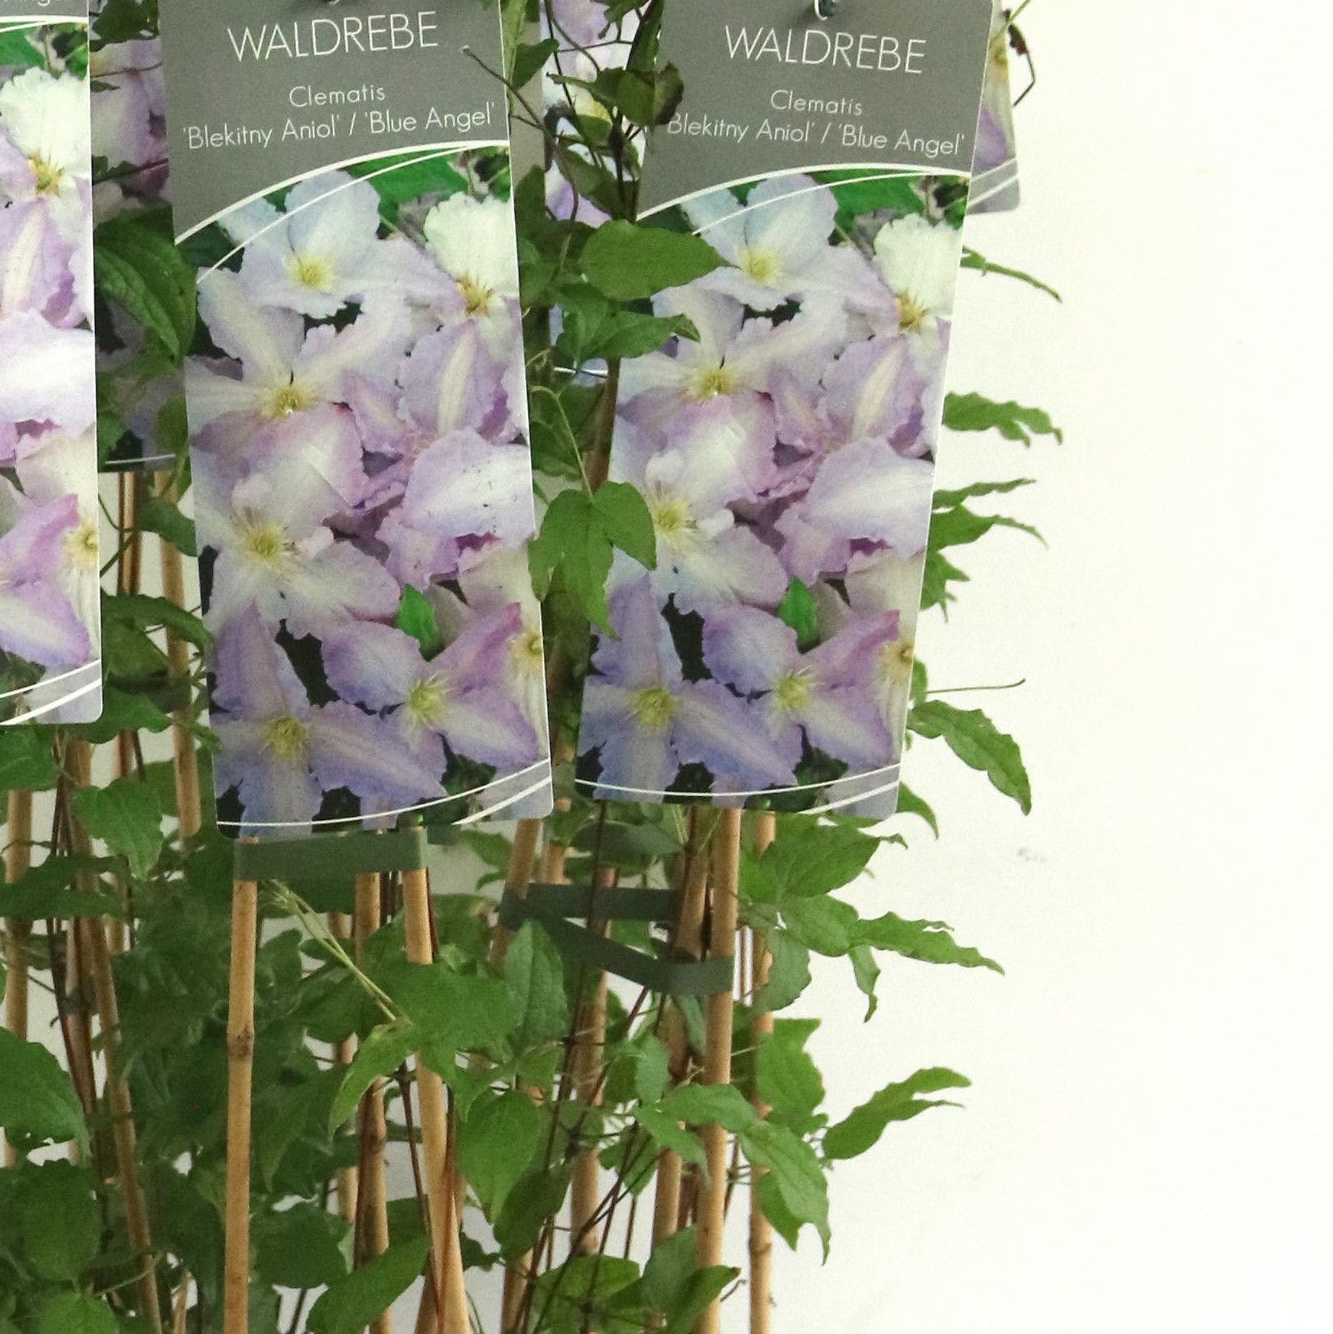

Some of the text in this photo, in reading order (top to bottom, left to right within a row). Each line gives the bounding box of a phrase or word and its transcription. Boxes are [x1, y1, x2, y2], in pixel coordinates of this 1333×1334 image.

[227, 10, 438, 62] WALDREBE
[724, 24, 927, 74] WALDREBE
[289, 84, 386, 108] Clematis
[770, 88, 863, 117] Clematis
[183, 101, 496, 149] 'Blekitny Aniol' / 'Blue Angel'
[667, 112, 966, 158] Blekitny Aniol' / 'Blue Angel'
